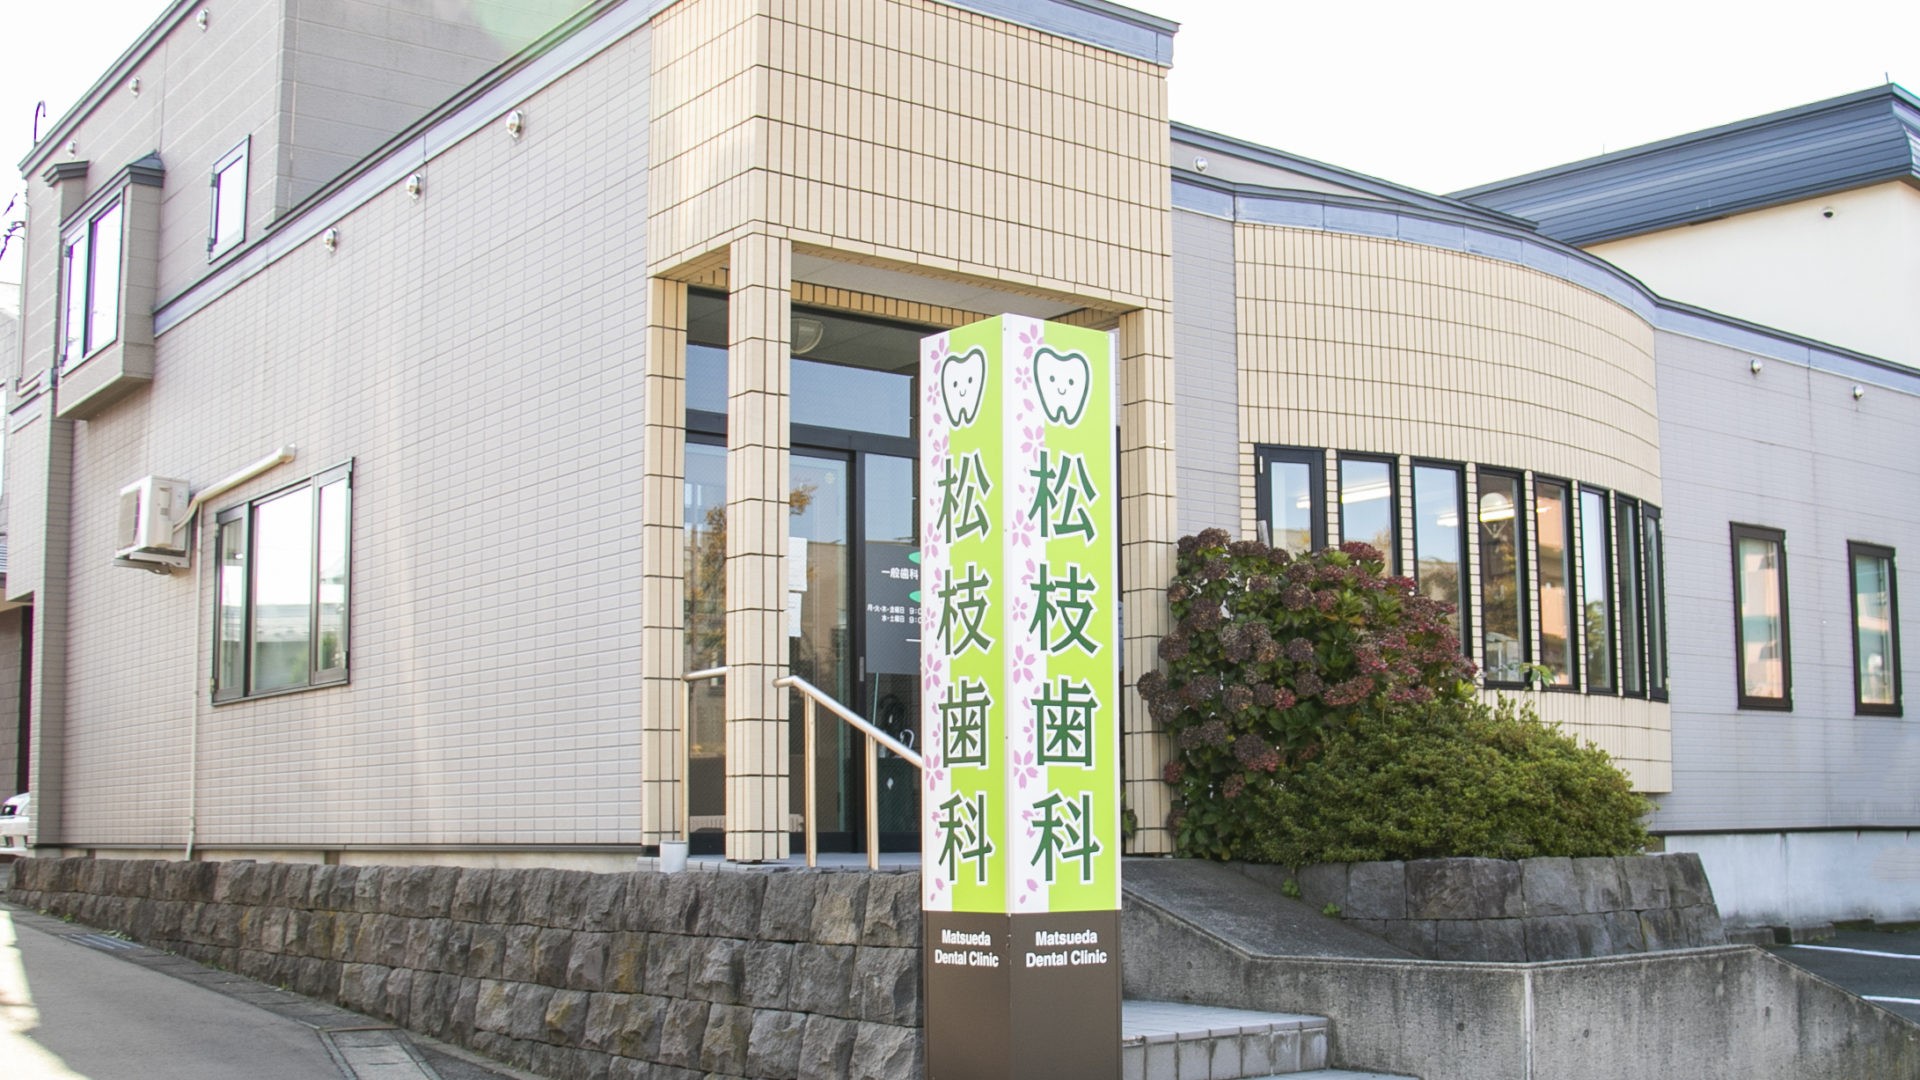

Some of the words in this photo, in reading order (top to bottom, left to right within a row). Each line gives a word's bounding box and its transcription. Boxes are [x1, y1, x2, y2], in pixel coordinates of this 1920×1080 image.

[881, 567, 919, 580] 一般歯科
[936, 453, 993, 882] 松枝歯科
[1028, 450, 1101, 882] 松枝歯科
[941, 929, 991, 946] Matsueda
[1035, 929, 1098, 946] Matsueda
[934, 949, 967, 965] Dental
[968, 951, 1000, 968] Clinic
[1025, 951, 1067, 968] Dental
[1070, 949, 1108, 966] Clinic
